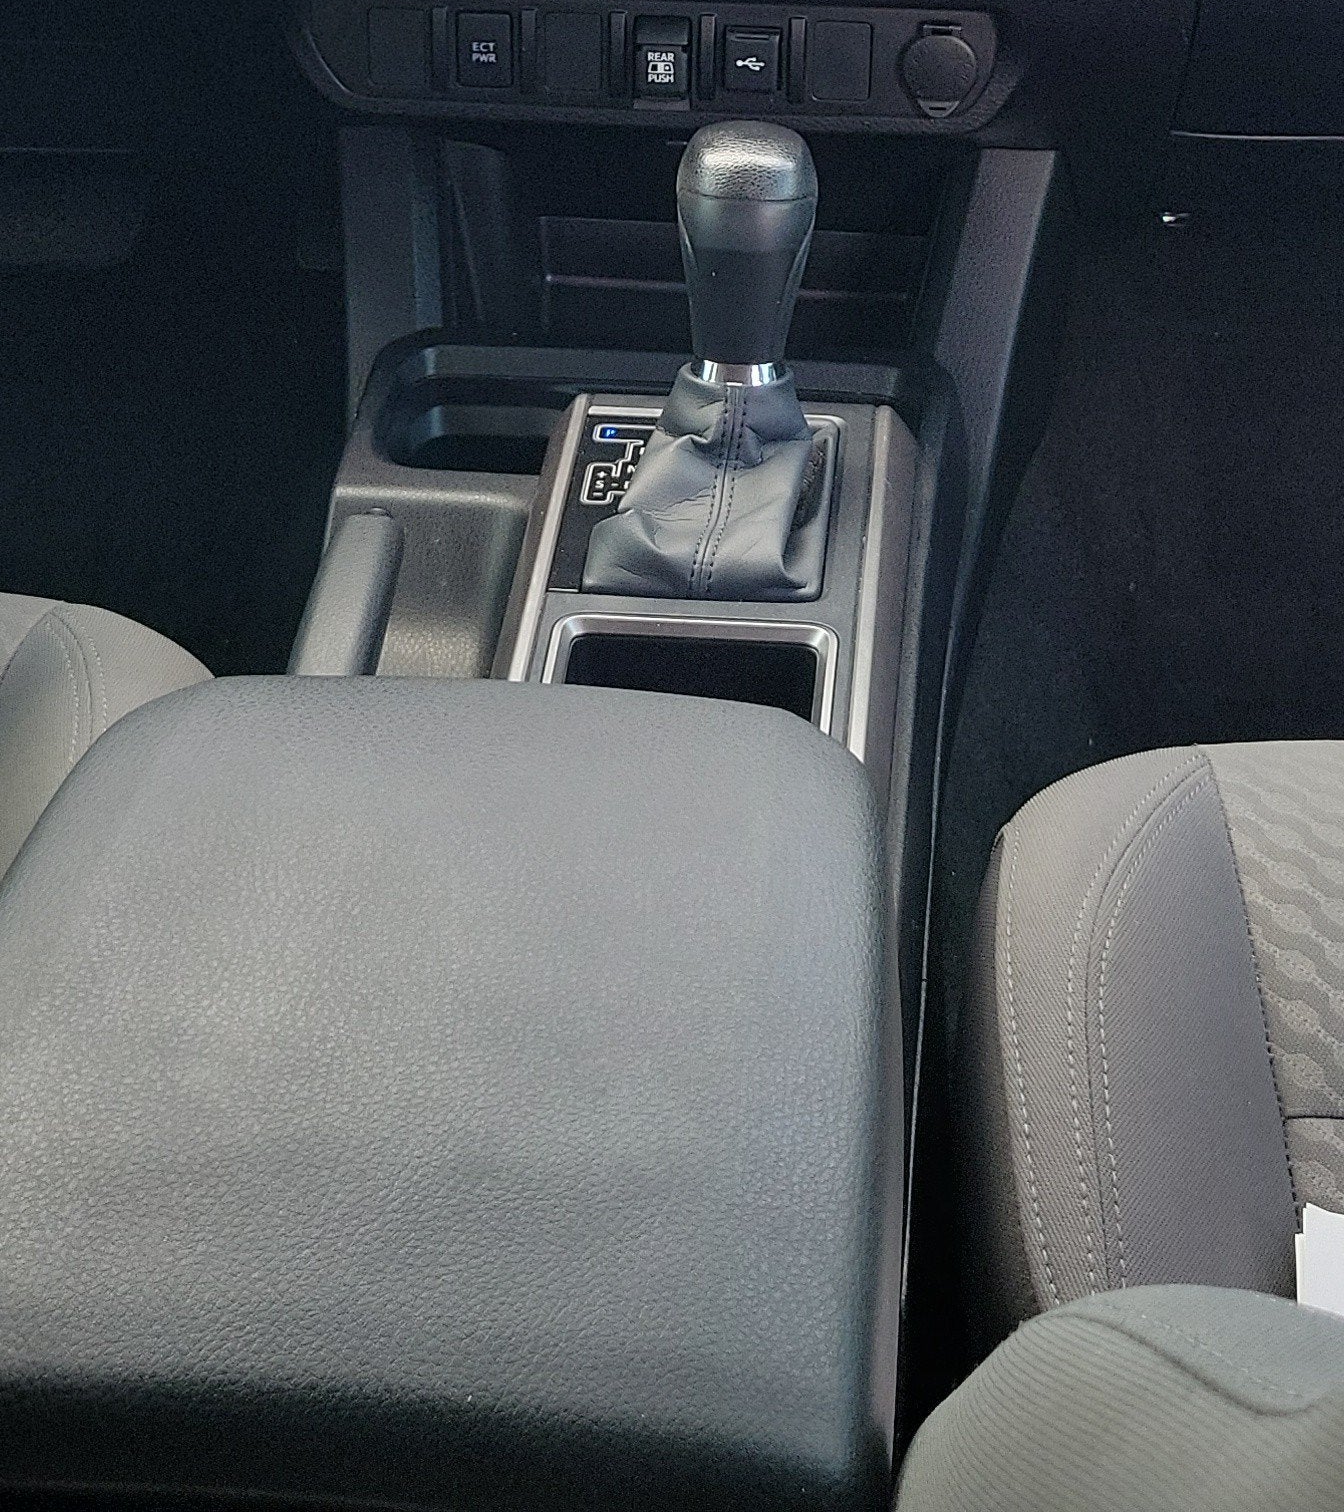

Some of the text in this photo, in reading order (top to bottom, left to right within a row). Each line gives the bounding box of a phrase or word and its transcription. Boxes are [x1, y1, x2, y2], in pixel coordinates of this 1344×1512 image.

[471, 41, 495, 52] ECT
[471, 52, 497, 63] PWR
[647, 52, 675, 62] REAR
[647, 73, 675, 84] PUSH
[594, 479, 606, 490] S
